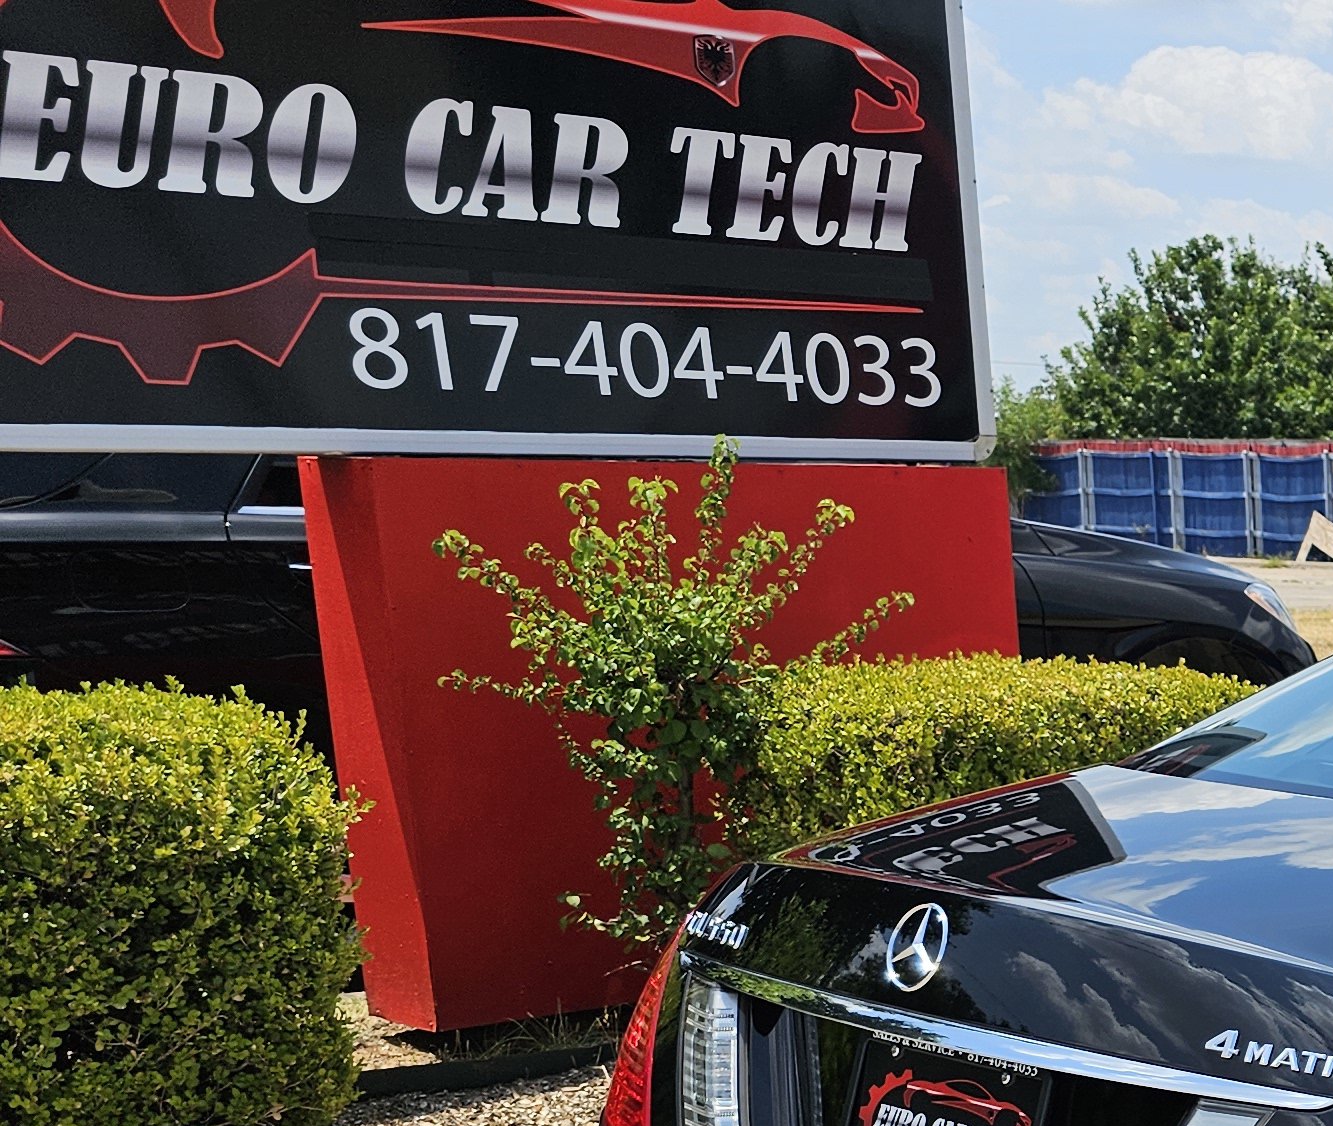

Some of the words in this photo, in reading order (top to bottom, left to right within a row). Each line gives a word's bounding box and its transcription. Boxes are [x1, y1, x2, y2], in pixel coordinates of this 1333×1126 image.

[0, 50, 358, 203] EURO
[404, 97, 630, 229] CAR
[669, 126, 923, 252] TECH
[348, 306, 942, 408] 817-404-4033
